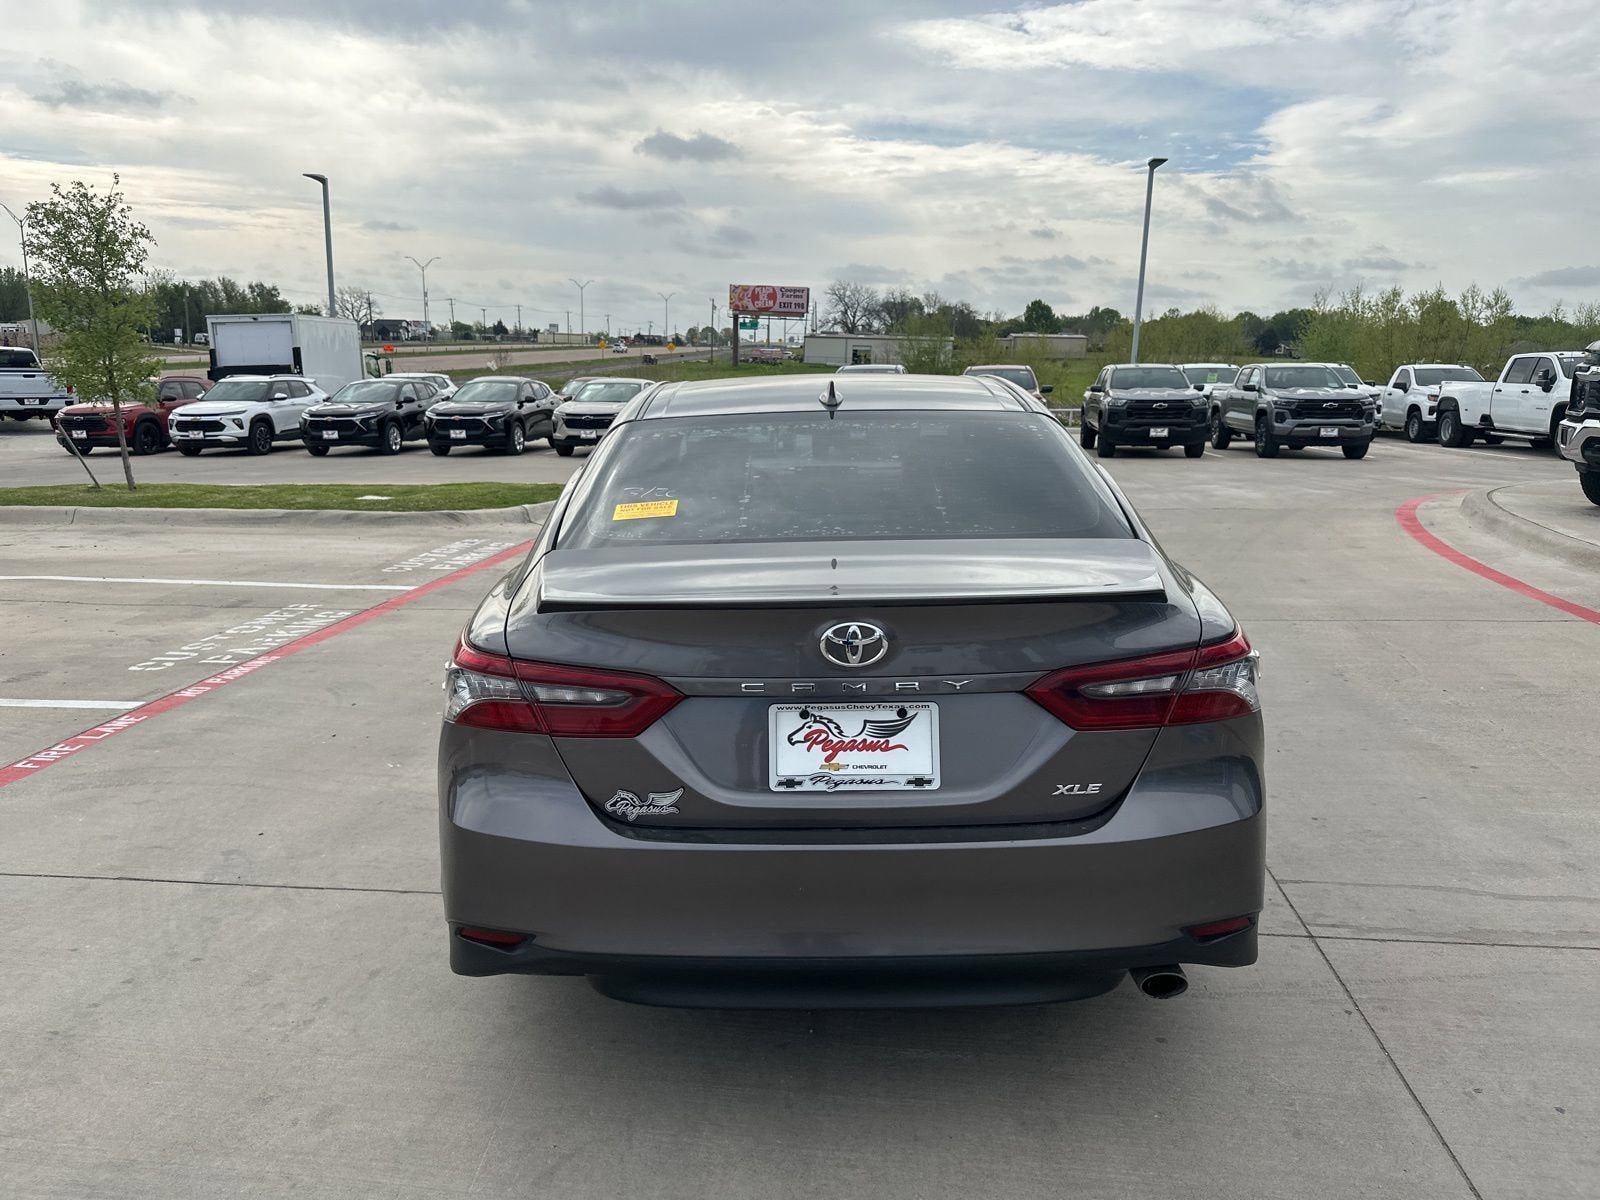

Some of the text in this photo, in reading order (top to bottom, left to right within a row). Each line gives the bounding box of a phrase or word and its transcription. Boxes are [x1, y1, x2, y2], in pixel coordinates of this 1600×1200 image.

[779, 286, 805, 294] Cooper
[779, 301, 793, 309] EXIT
[381, 538, 491, 573] CUSTOMER
[429, 542, 516, 570] PARKING
[127, 603, 324, 672] CUSTOMER
[198, 610, 354, 665] PARKING
[741, 679, 974, 693] CAMRY
[13, 655, 281, 769] FIRE LANE NO PARKING
[776, 703, 931, 712] www.PegasusChevyTexas.com
[803, 728, 910, 764] Pegasus
[809, 774, 901, 790] Pegasus
[1050, 783, 1103, 796] XLE
[616, 800, 680, 821] Pegasus
